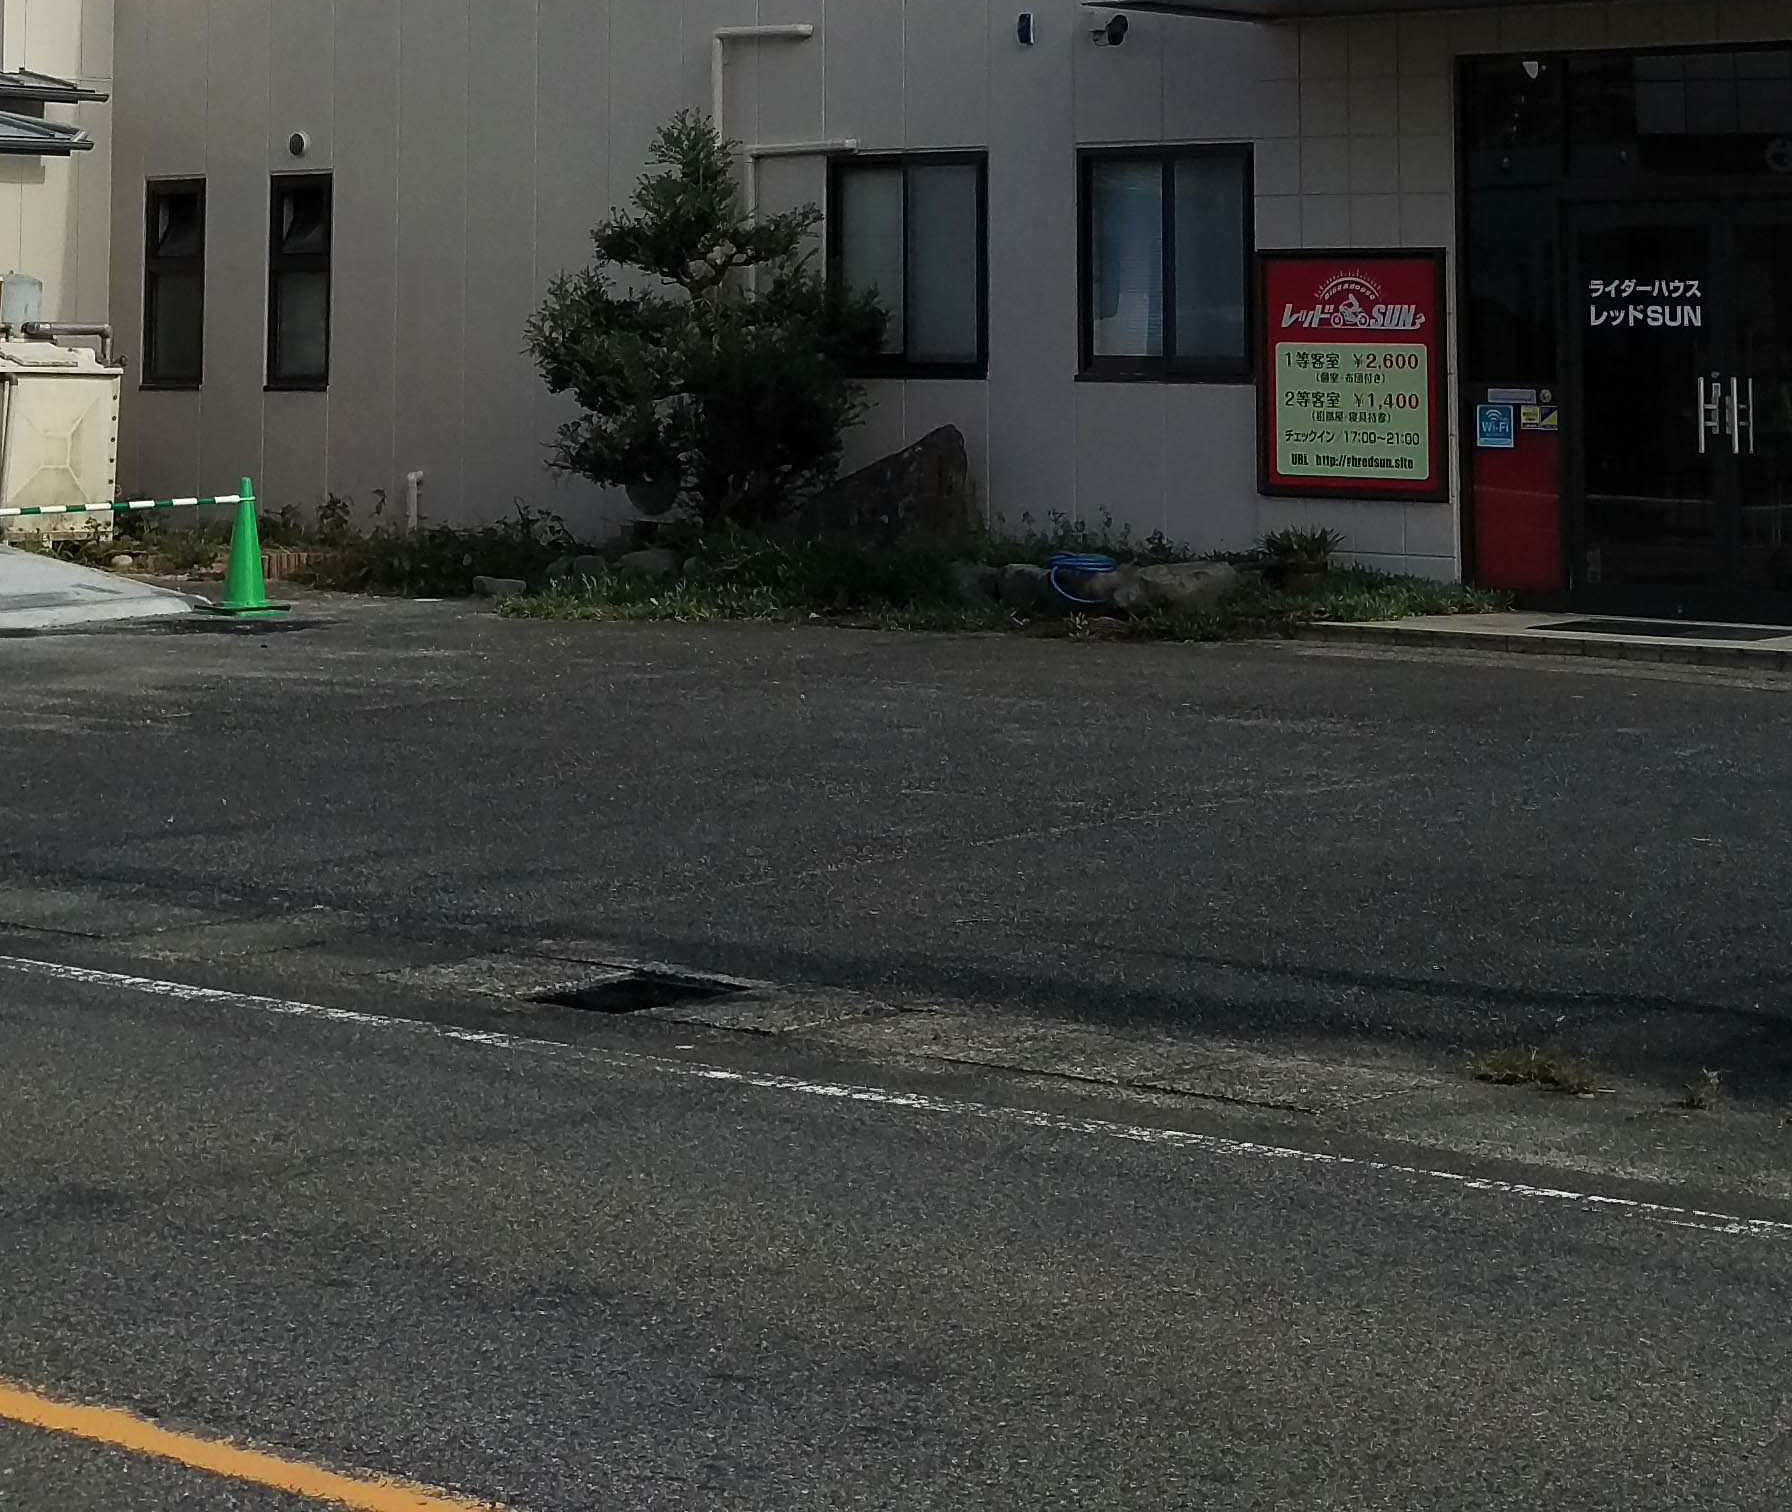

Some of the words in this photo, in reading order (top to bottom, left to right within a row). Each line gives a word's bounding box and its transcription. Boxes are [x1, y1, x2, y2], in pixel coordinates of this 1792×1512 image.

[1589, 279, 1701, 297] ライダーハウス
[1281, 304, 1334, 328] レッド
[1370, 304, 1416, 328] SUN
[1590, 305, 1701, 326] レッドSUN
[1285, 352, 1340, 369] 1等客室
[1353, 353, 1419, 369] ¥2,600
[1285, 391, 1340, 408] 2等客室
[1353, 393, 1419, 410] ¥1,400
[1481, 421, 1510, 433] Wi-Fi
[1285, 429, 1335, 443] チェックイン
[1291, 453, 1309, 466] URL
